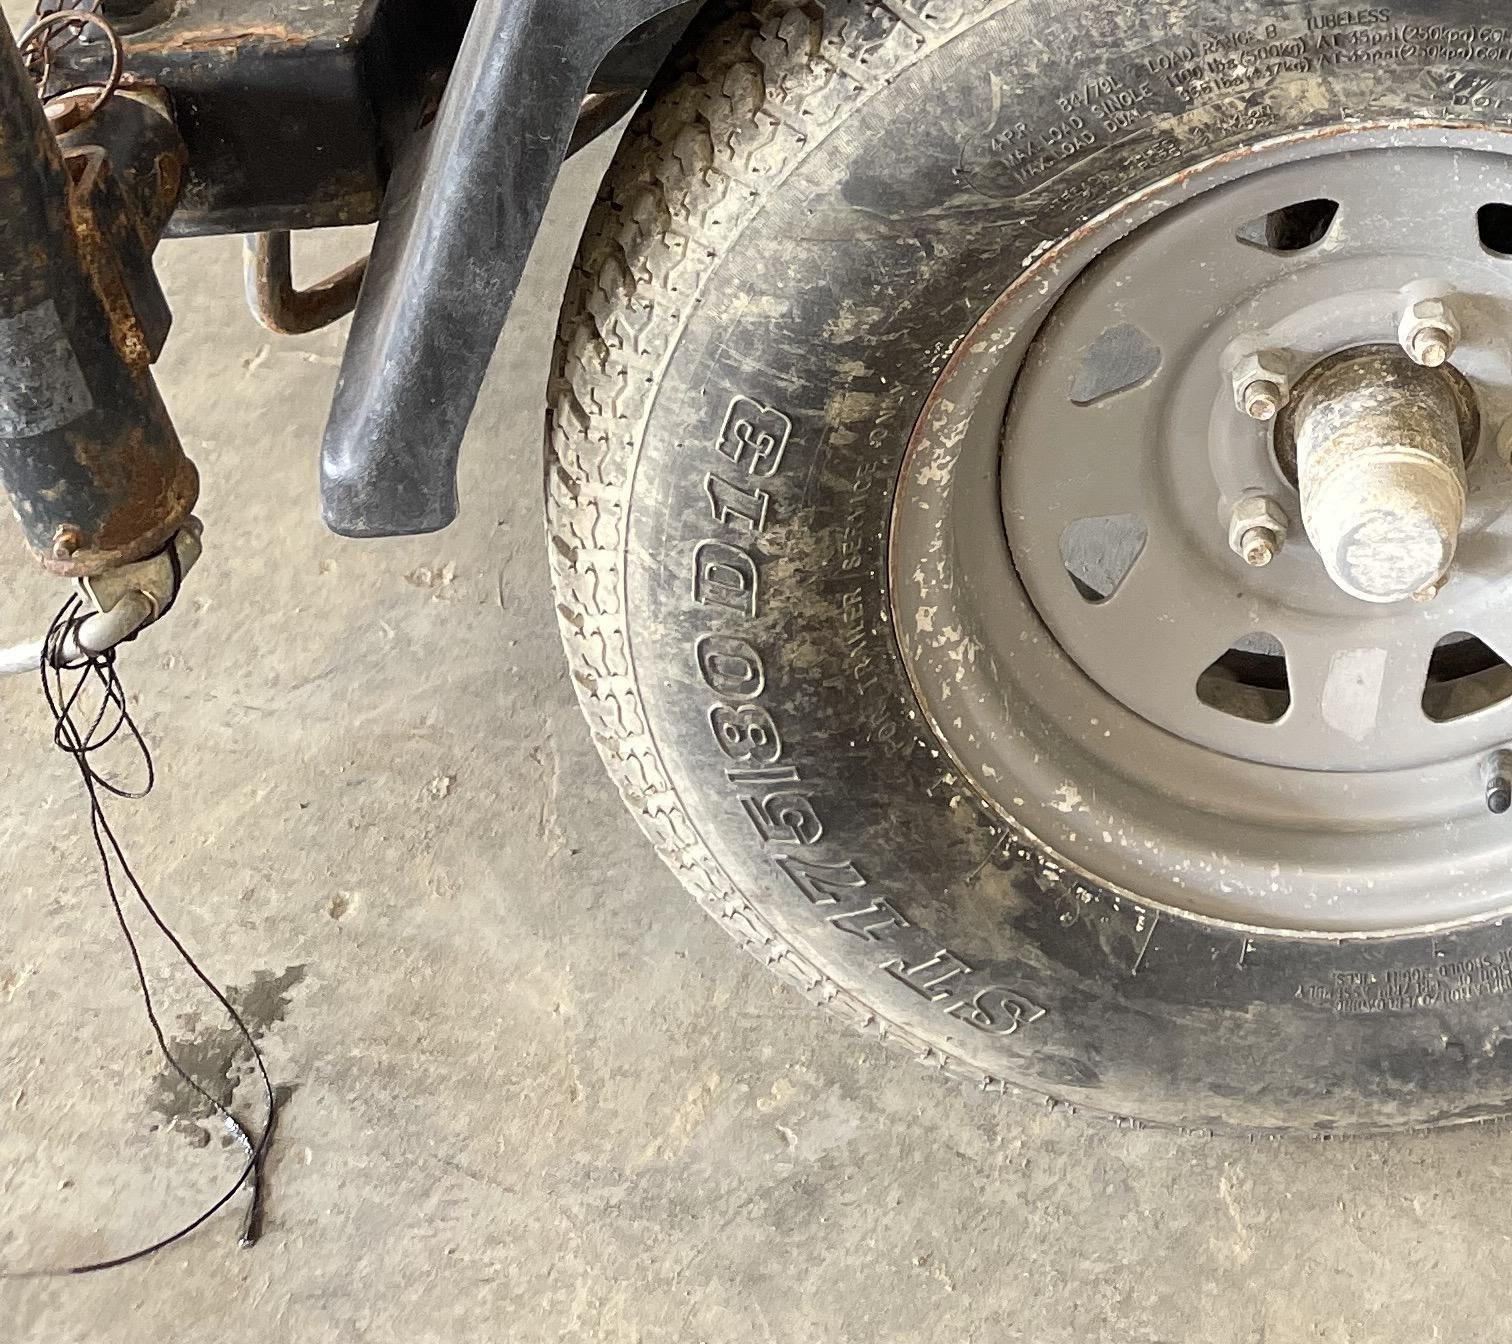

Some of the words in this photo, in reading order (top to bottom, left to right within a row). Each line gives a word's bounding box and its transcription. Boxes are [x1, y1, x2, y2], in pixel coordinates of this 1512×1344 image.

[1147, 46, 1195, 74] LOAD
[1264, 23, 1278, 40] B
[1306, 8, 1390, 31] TUBELESS
[1040, 115, 1084, 145] LOAD
[1091, 80, 1153, 118] SINGLE
[1053, 129, 1096, 160] LOAD
